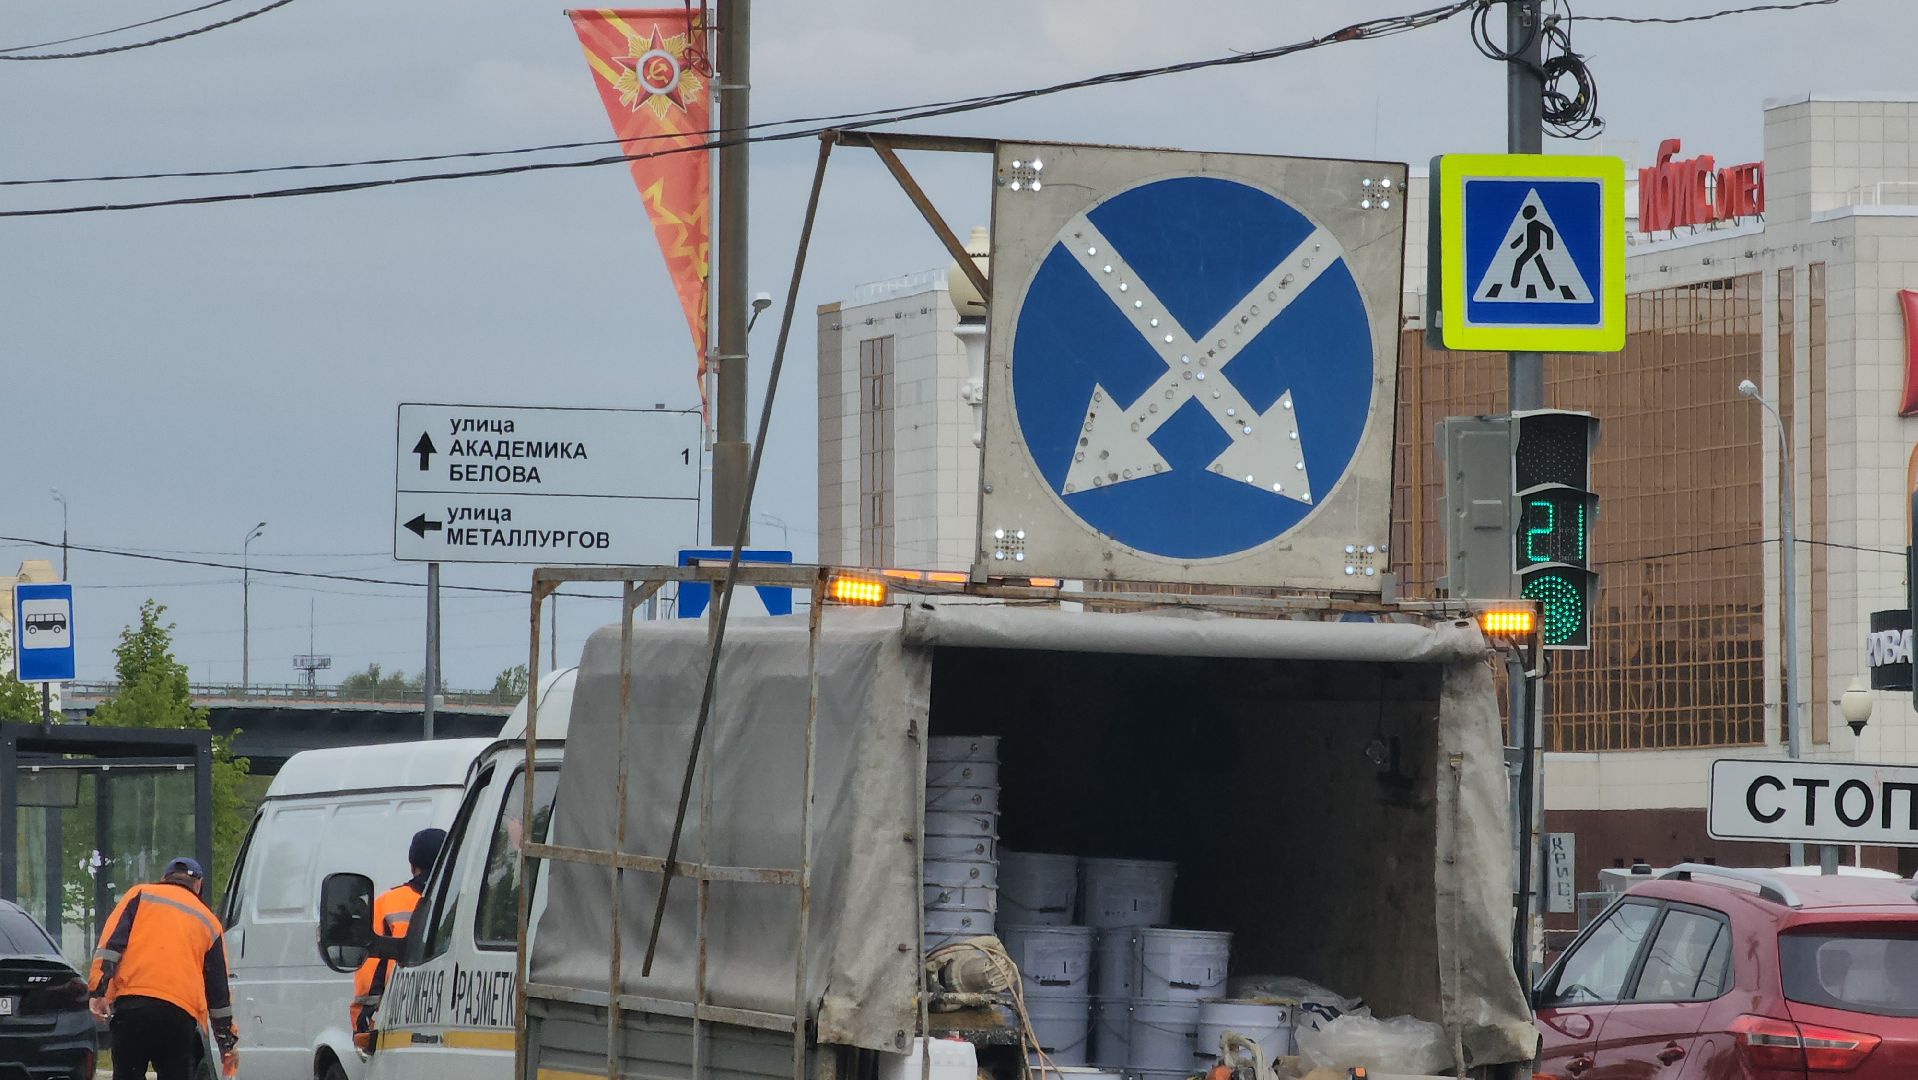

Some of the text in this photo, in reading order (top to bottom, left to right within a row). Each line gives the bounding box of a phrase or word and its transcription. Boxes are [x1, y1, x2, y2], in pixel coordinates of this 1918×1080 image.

[450, 418, 515, 434] улица
[449, 439, 690, 466] АКАДЕМИКА 1
[449, 464, 542, 484] БЕЛОВА
[447, 506, 513, 523] улица
[446, 527, 610, 549] МЕТАЛЛУРГОВ
[1527, 500, 1584, 562] 21
[1745, 774, 1918, 831] СТОП
[456, 970, 517, 1026] РАЗМЕТК
